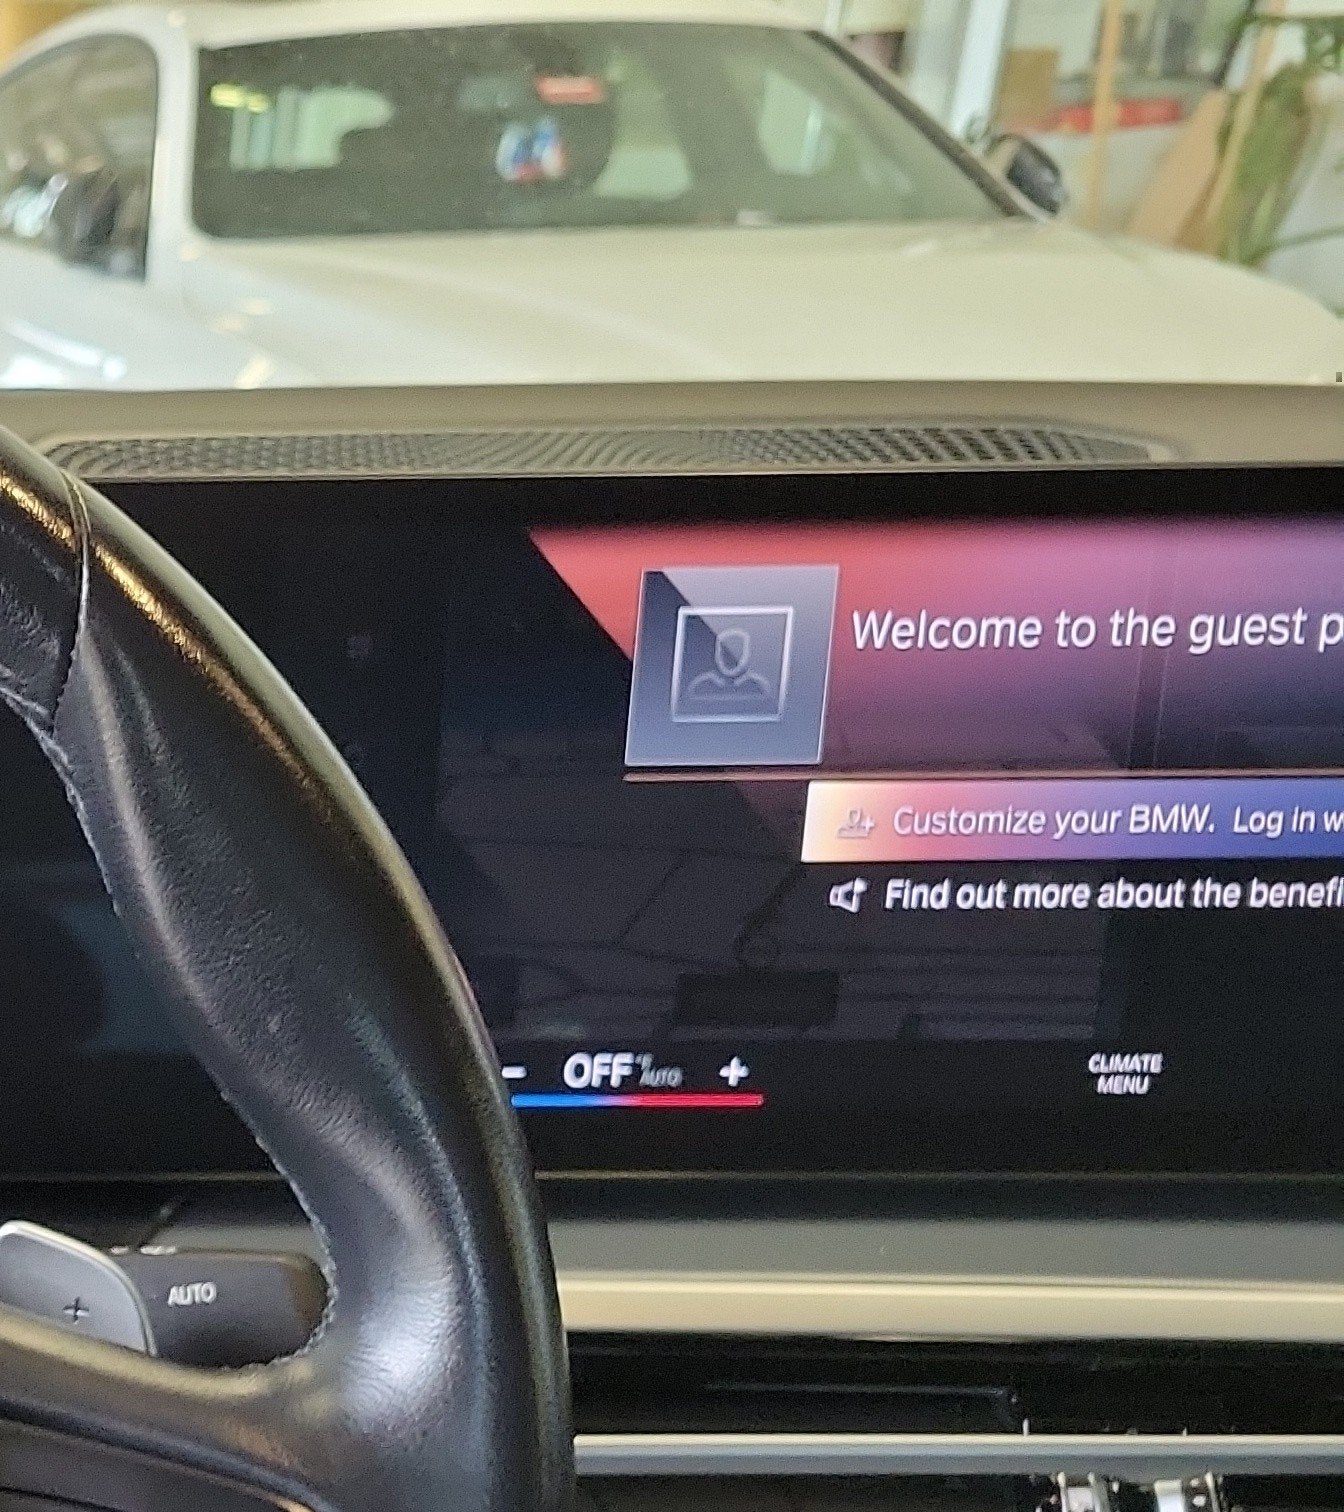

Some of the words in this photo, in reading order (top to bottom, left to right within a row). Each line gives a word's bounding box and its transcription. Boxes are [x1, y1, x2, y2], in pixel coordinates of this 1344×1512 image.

[852, 609, 1042, 650] Welcome
[1055, 611, 1096, 648] to
[1109, 607, 1176, 648] the
[1189, 606, 1308, 655] guest
[1318, 612, 1344, 654] p
[892, 804, 1045, 834] Customize
[1053, 809, 1122, 840] your
[1128, 803, 1215, 834] BMW.
[1233, 805, 1284, 839] Log
[885, 877, 951, 910] Find
[957, 880, 1007, 910] out
[1013, 882, 1091, 910] more
[1097, 877, 1186, 910] about
[1192, 877, 1242, 908] the
[563, 1052, 634, 1089] OFF
[1088, 1052, 1162, 1074] CLIMATE
[1097, 1074, 1150, 1095] MENU
[167, 1281, 217, 1306] AUTO
